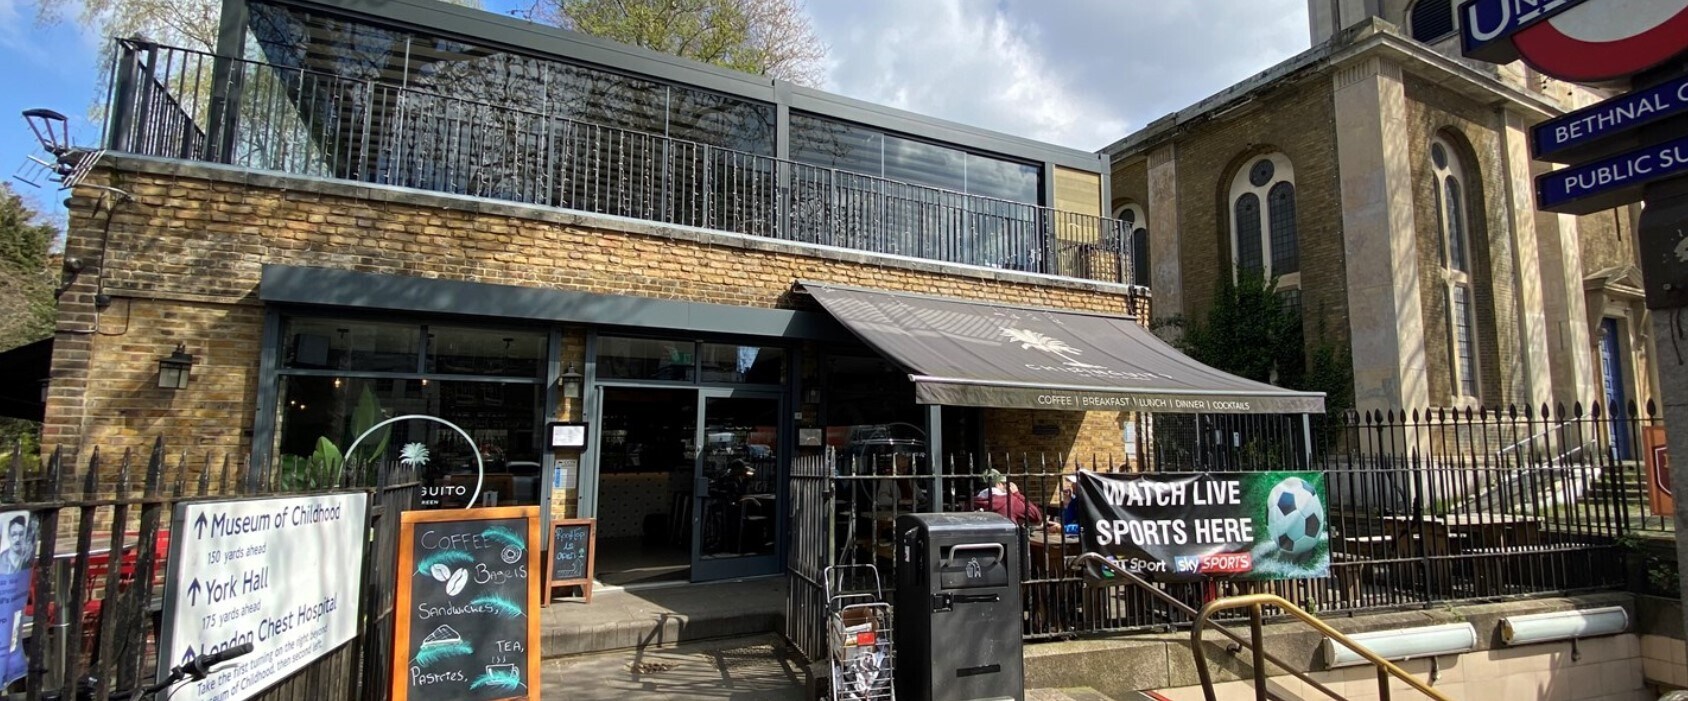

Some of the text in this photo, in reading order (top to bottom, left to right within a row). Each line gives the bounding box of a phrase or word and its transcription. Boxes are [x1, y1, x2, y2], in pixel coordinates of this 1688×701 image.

[1555, 93, 1670, 144] BETHNAL
[1564, 155, 1652, 194] PUBLIC
[1037, 394, 1251, 411] COFFEE BREAKFAST LUNCH DINNER COCKTAILS
[1103, 480, 1241, 507] WATCH LIVE
[211, 501, 341, 539] Museum of Childhood
[1096, 517, 1255, 546] SPORTS HERE
[207, 542, 267, 565] 150 yards ahead
[1130, 557, 1166, 573] Sport
[1177, 554, 1250, 574] sky SPORTS
[206, 566, 269, 605] York Hall
[202, 600, 262, 630] 175 yards ahead
[258, 610, 294, 642] Chest
[297, 593, 337, 627] Hospital
[198, 680, 216, 697] Take
[218, 672, 232, 686] the
[233, 663, 249, 679] first
[275, 646, 283, 657] on
[284, 641, 295, 652] the
[231, 680, 240, 695] of
